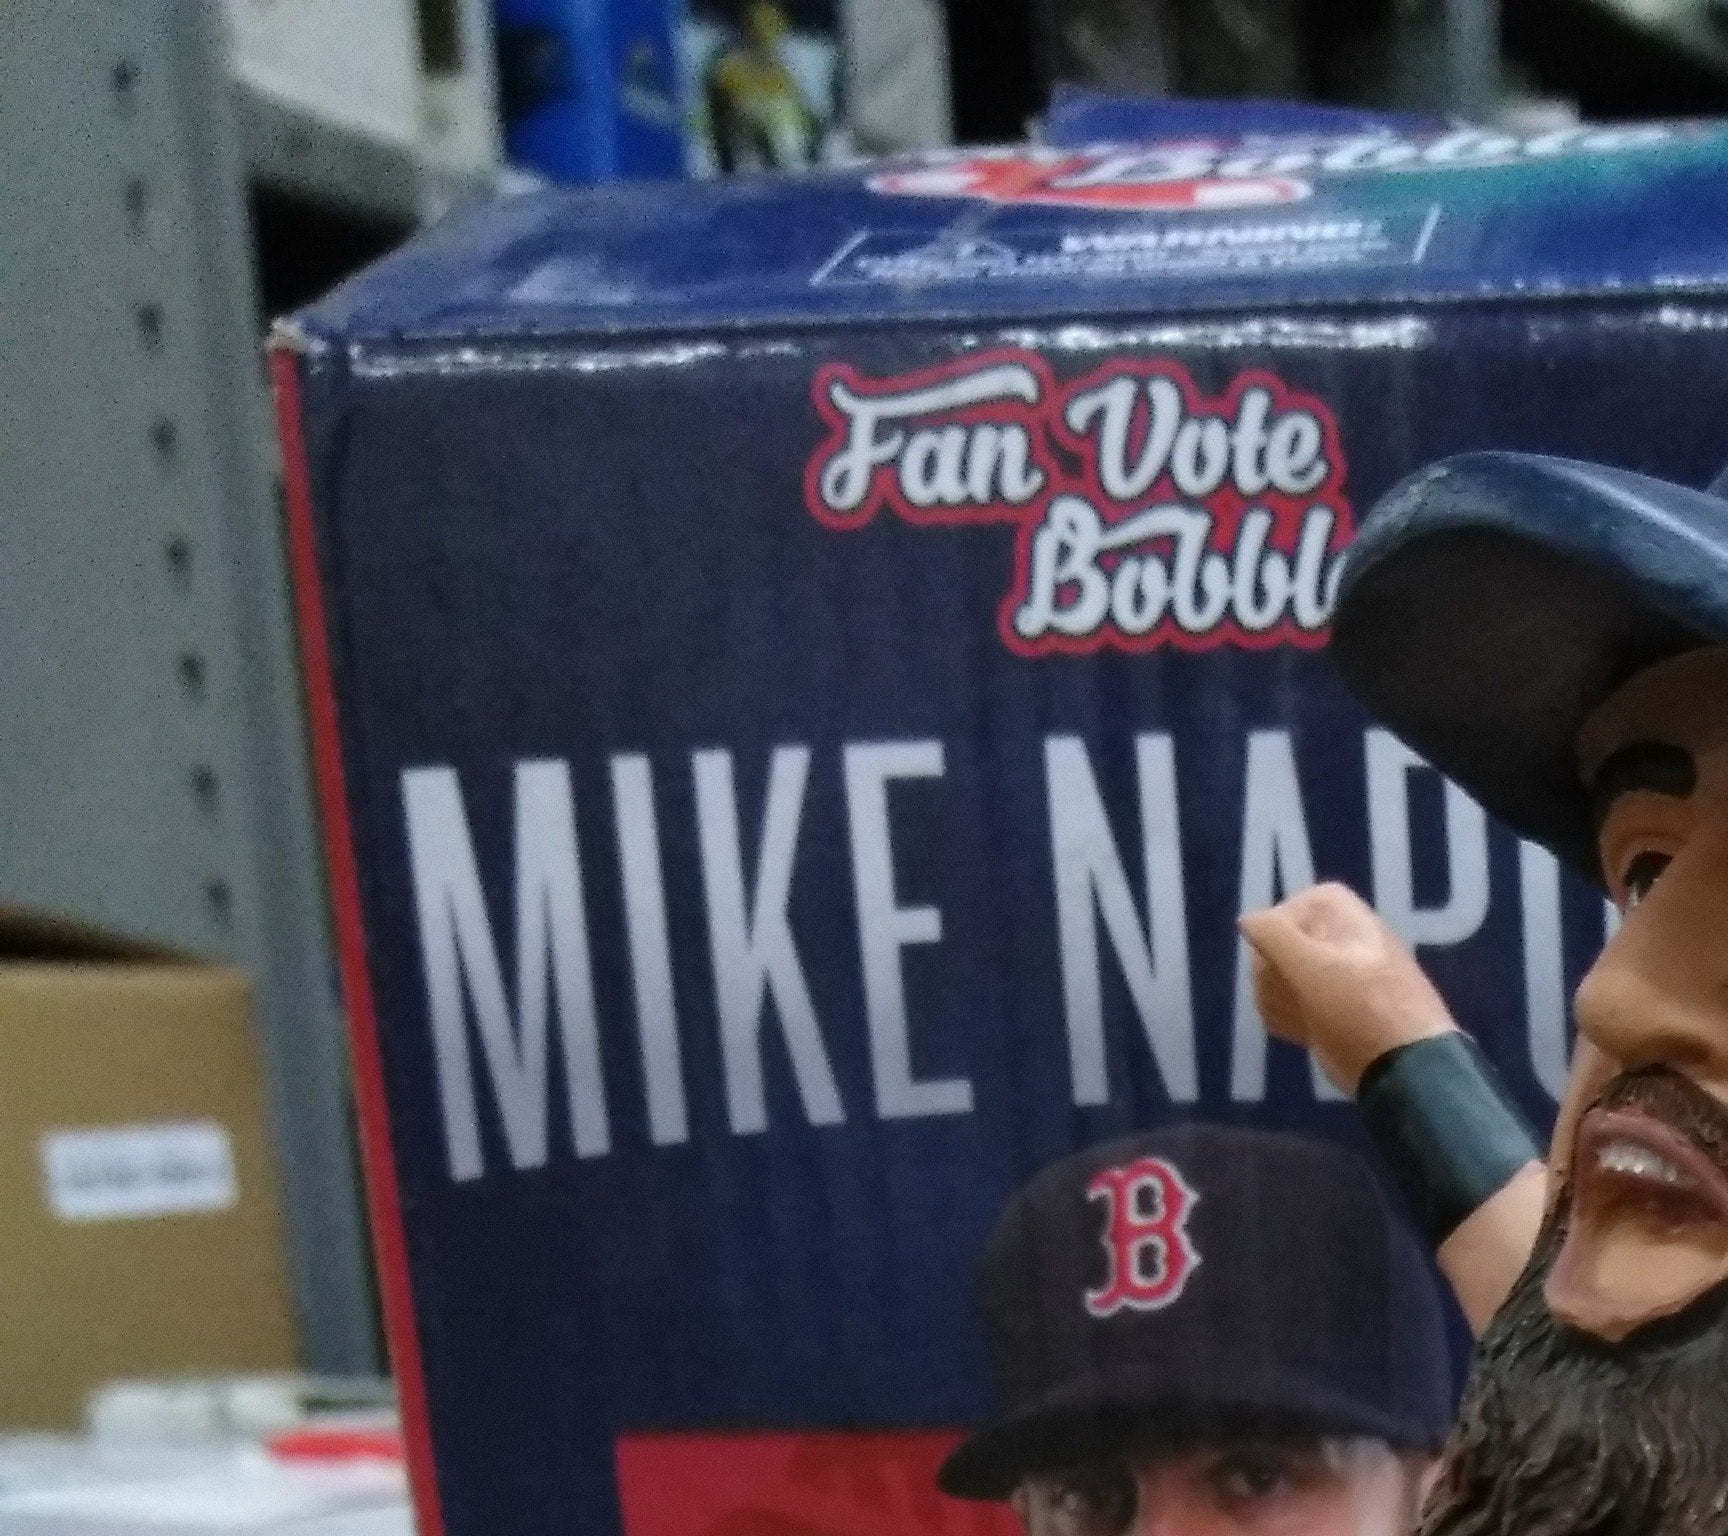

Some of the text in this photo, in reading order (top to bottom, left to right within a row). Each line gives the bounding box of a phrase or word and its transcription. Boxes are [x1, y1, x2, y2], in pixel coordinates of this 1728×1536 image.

[821, 363, 1329, 510] Fan Vote
[1015, 495, 1347, 637] Bobbl
[402, 741, 974, 1182] MIKE
[1084, 1157, 1202, 1318] B
